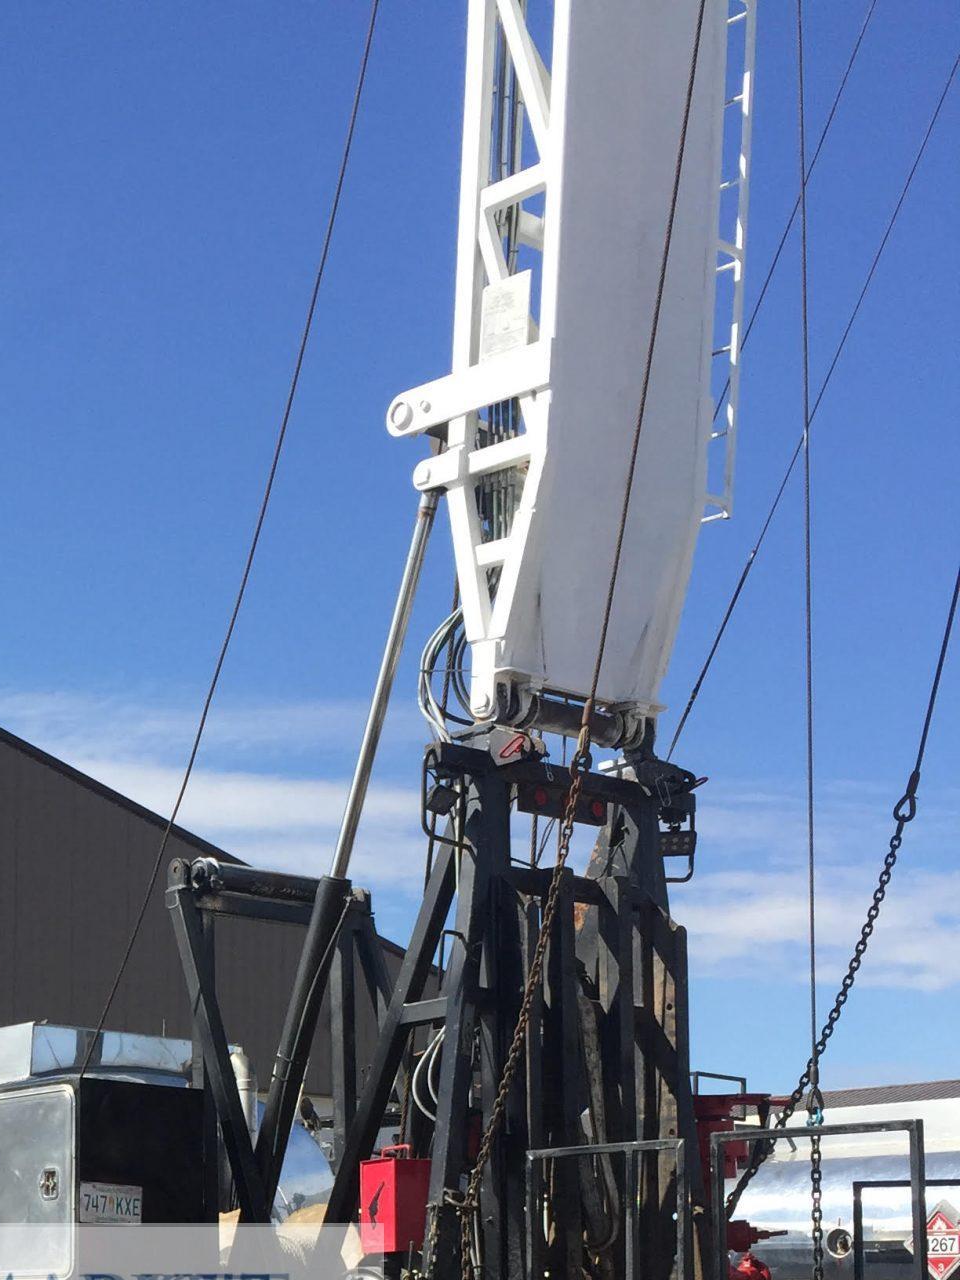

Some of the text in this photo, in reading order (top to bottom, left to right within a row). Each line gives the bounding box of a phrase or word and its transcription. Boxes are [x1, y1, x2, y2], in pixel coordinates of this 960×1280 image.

[84, 1194, 140, 1216] 747 KXE
[938, 1263, 945, 1272] 3
